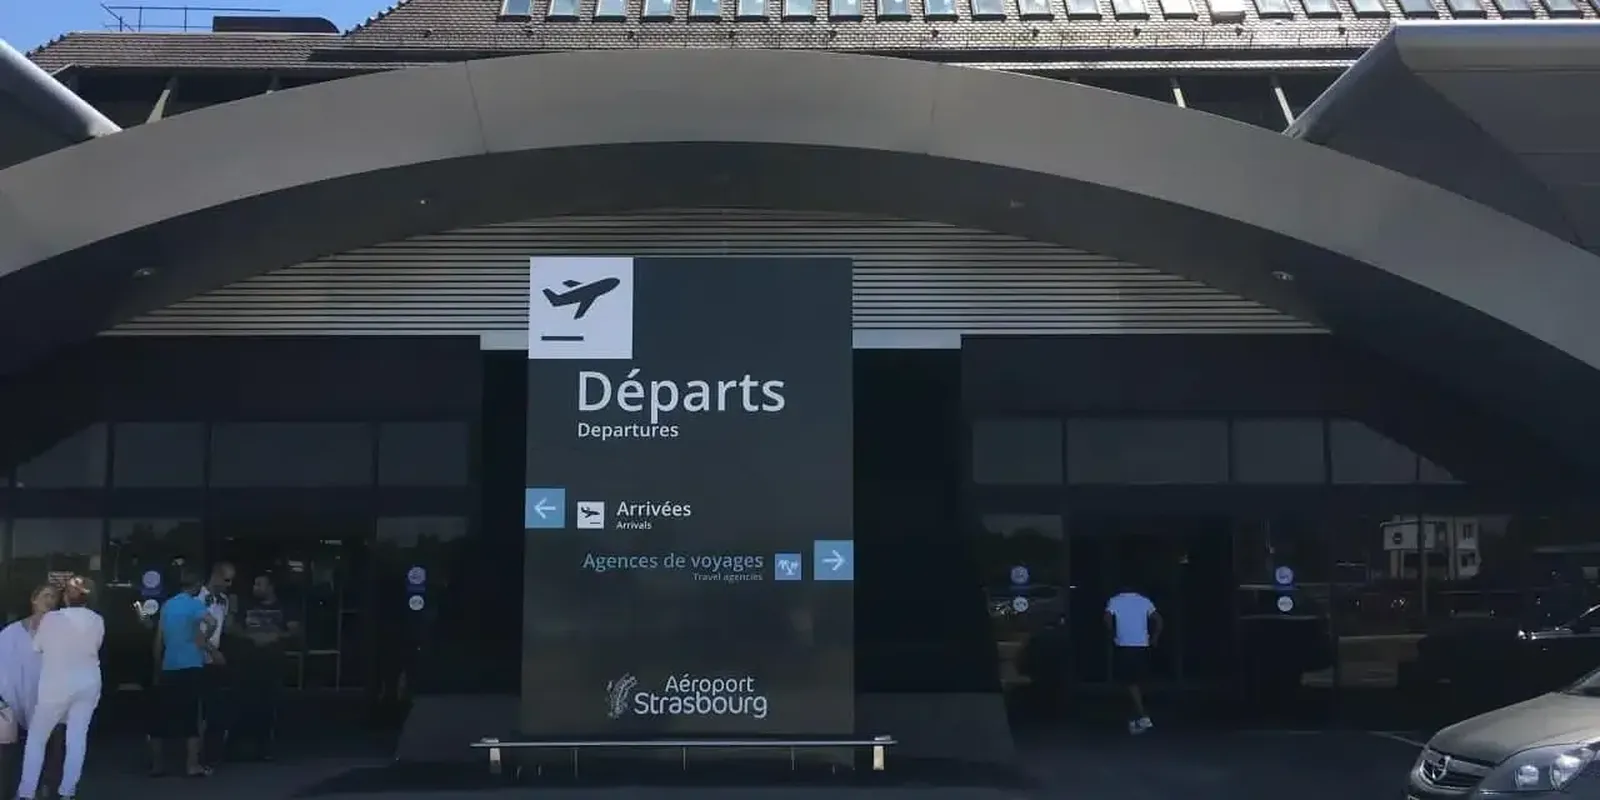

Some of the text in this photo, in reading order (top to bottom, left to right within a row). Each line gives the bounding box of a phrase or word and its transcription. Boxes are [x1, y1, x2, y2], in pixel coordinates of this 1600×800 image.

[577, 368, 786, 424] Départs
[577, 423, 679, 441] Departures
[616, 500, 692, 517] Arrivées
[616, 520, 653, 530] Arrivals
[582, 553, 764, 572] Agences de voyages
[693, 572, 764, 583] Travel agencies
[665, 673, 755, 696] Aéroport
[633, 691, 768, 719] Strasbourg
